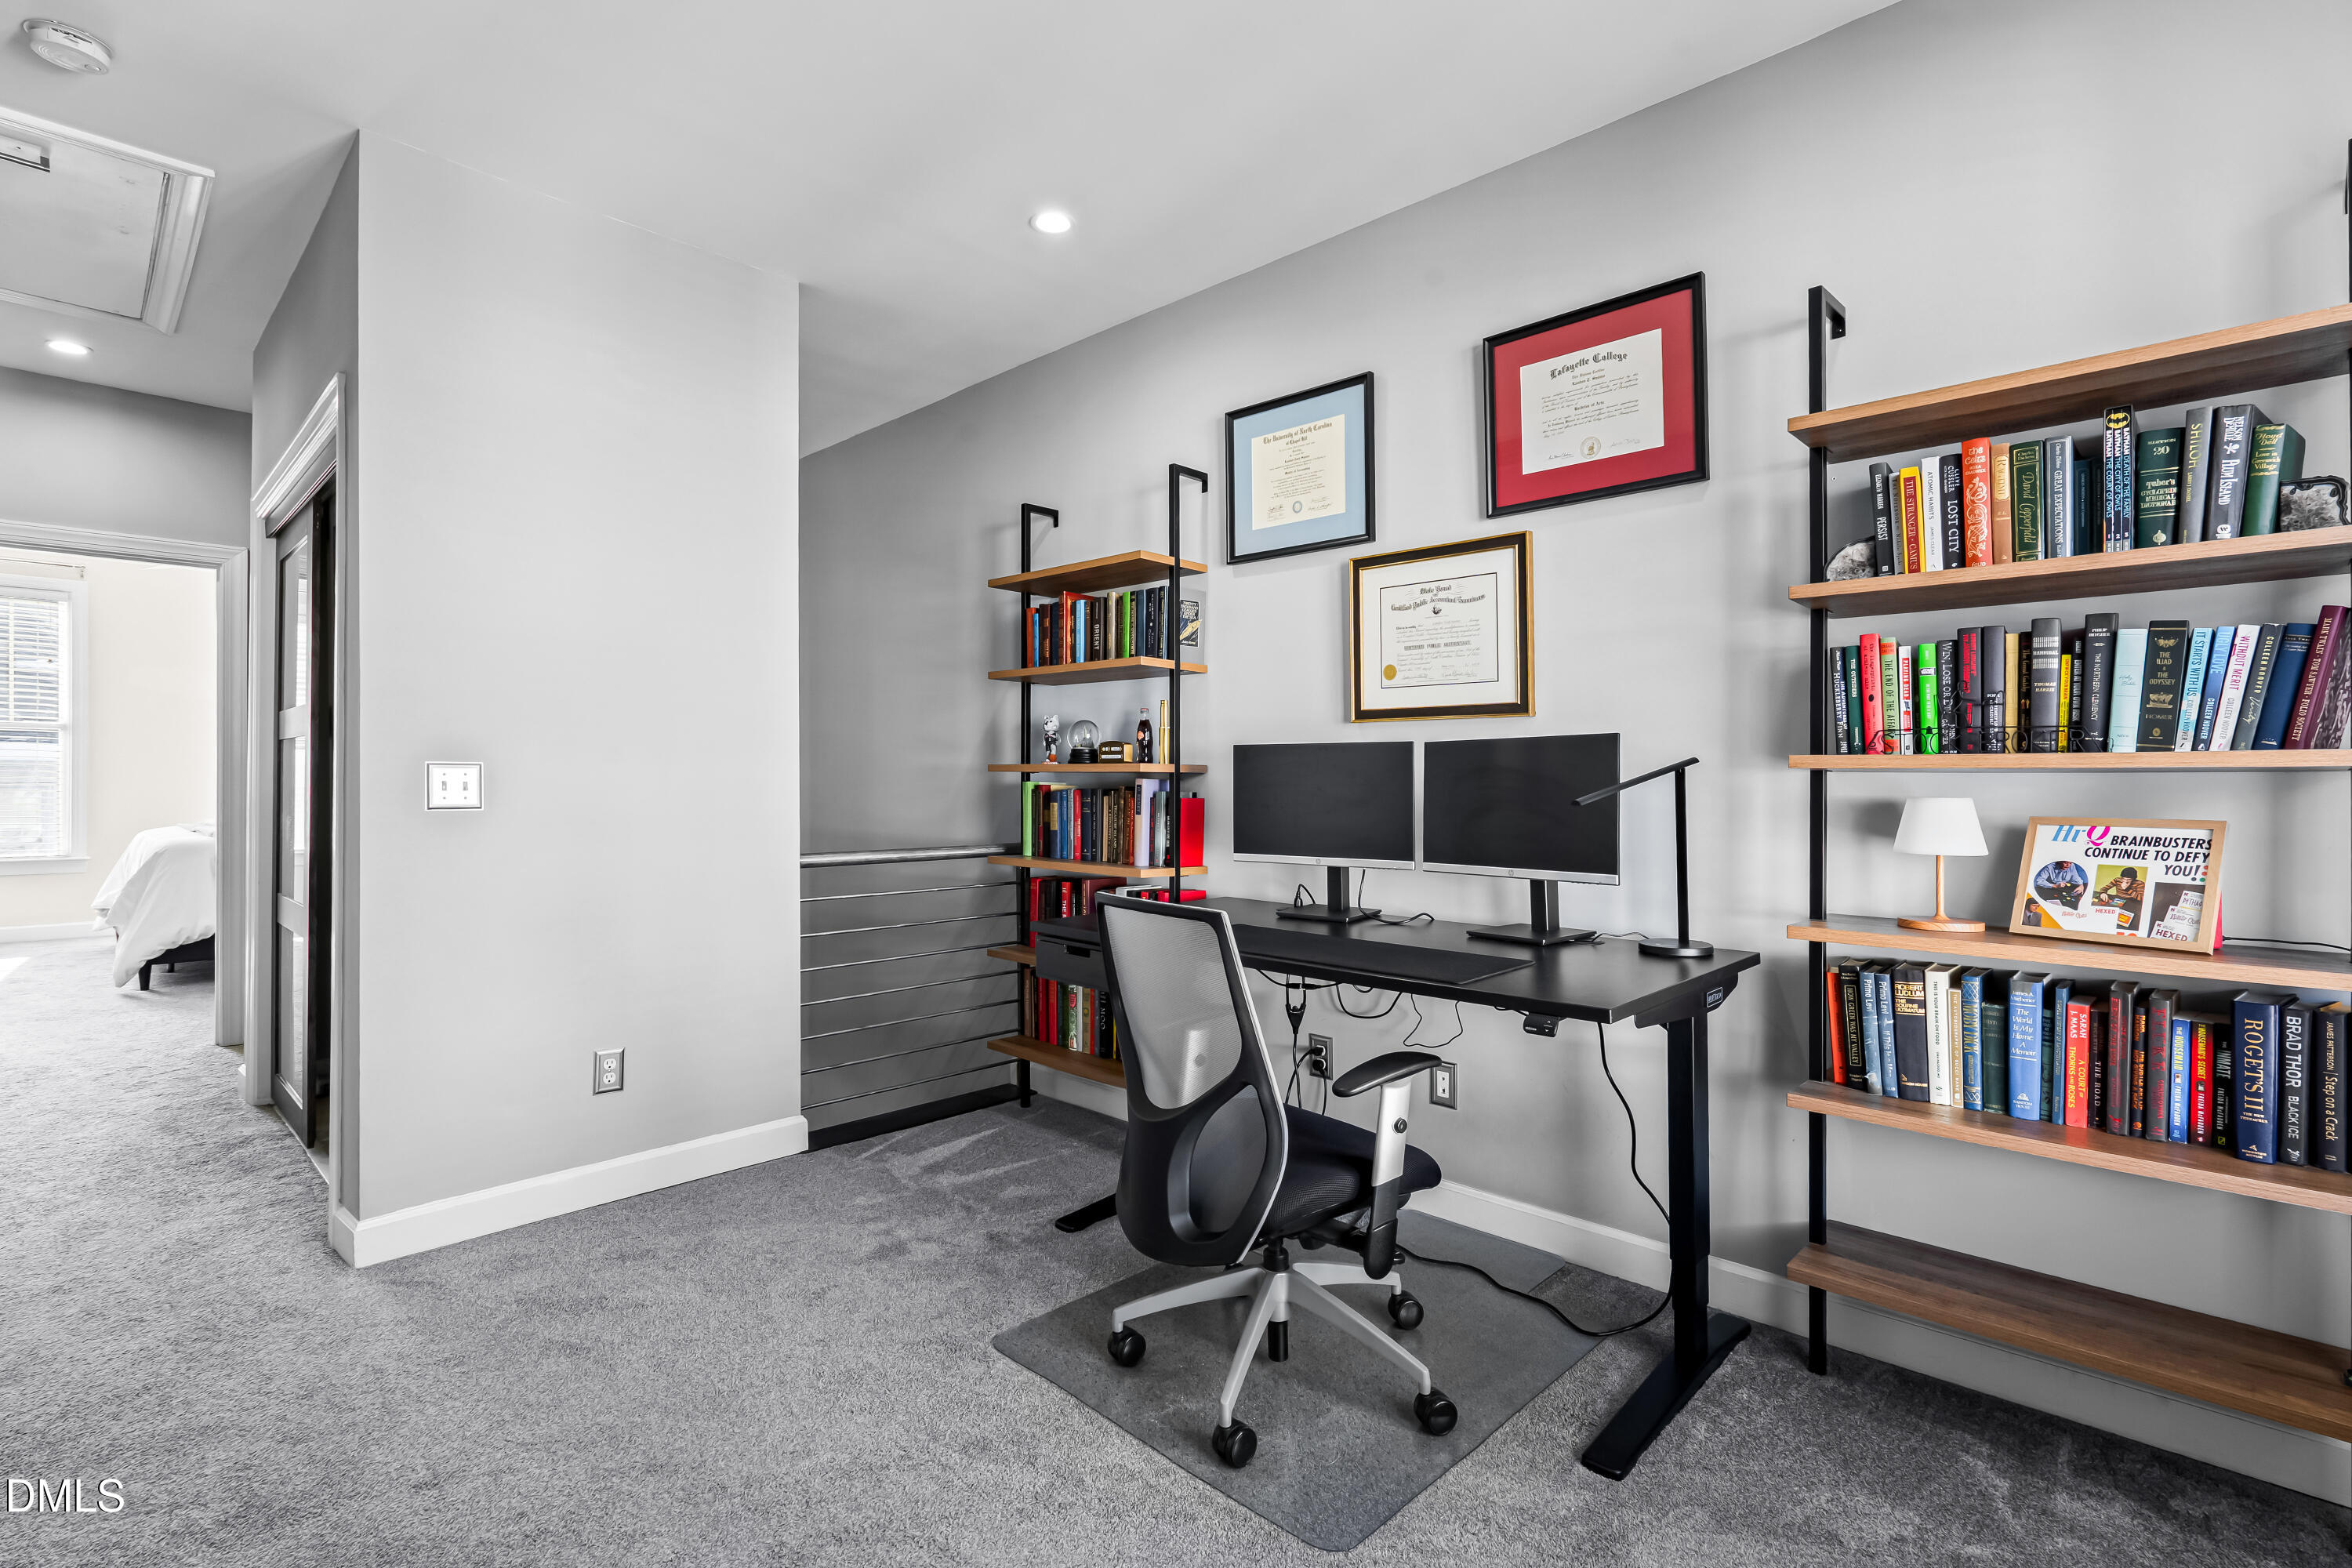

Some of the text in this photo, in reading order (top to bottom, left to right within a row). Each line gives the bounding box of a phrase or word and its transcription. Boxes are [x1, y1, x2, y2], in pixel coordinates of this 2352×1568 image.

[1550, 358, 1589, 380] Lafayette
[1593, 352, 1628, 362] College
[1313, 422, 1332, 431] Carolina
[2153, 445, 2170, 456] 20
[2189, 423, 2202, 469] SHILOH
[1905, 481, 1916, 536] THE STRANGER
[2020, 471, 2036, 543] David Copperfield
[2054, 495, 2063, 543] EXPECTATIONS
[1877, 517, 1888, 541] PERSIST
[1948, 500, 1958, 553] LOST CITY
[1908, 543, 1918, 570] CAMUS
[2315, 617, 2333, 655] MARK TWAIN
[2187, 631, 2205, 697] IT STARTS WITH US
[2211, 632, 2230, 675] UGLY LOVE
[2229, 636, 2250, 691] WITHOUT MERIT
[2254, 636, 2274, 694] COLLEEN HOOVER
[1885, 674, 1893, 687] END
[1941, 642, 1954, 699] WIN, LOSE OR
[2304, 668, 2318, 695] SAWYER
[1886, 699, 1895, 712] THE
[2091, 694, 2100, 721] CLEMENCY
[2200, 698, 2215, 739] COLLEEN HOOVER
[2220, 698, 2234, 739] COLLEEN HOOVER
[2242, 696, 2260, 724] Verity
[2292, 699, 2310, 741] FOLIO SOCIETY
[2085, 848, 2210, 863] CONTINUE TO DEFY
[2110, 835, 2212, 850] BRAINBUSTERS
[2165, 865, 2201, 877] YOU!
[2156, 929, 2188, 941] HEXED
[1847, 1002, 1856, 1019] GREEN
[2013, 1015, 2033, 1024] World
[1850, 1033, 1857, 1043] MY
[1962, 1003, 1979, 1054] MOBY DICK
[2010, 1047, 2037, 1056] Memoir
[2174, 1036, 2183, 1071] HOUSEMAID
[2244, 1018, 2264, 1111] ROGET'S II
[2285, 1016, 2302, 1088] BRAD THOR
[2322, 1073, 2338, 1096] Step
[2288, 1095, 2299, 1139] BLACK ICE
[2325, 1098, 2335, 1108] on
[2325, 1116, 2339, 1141] Crack
